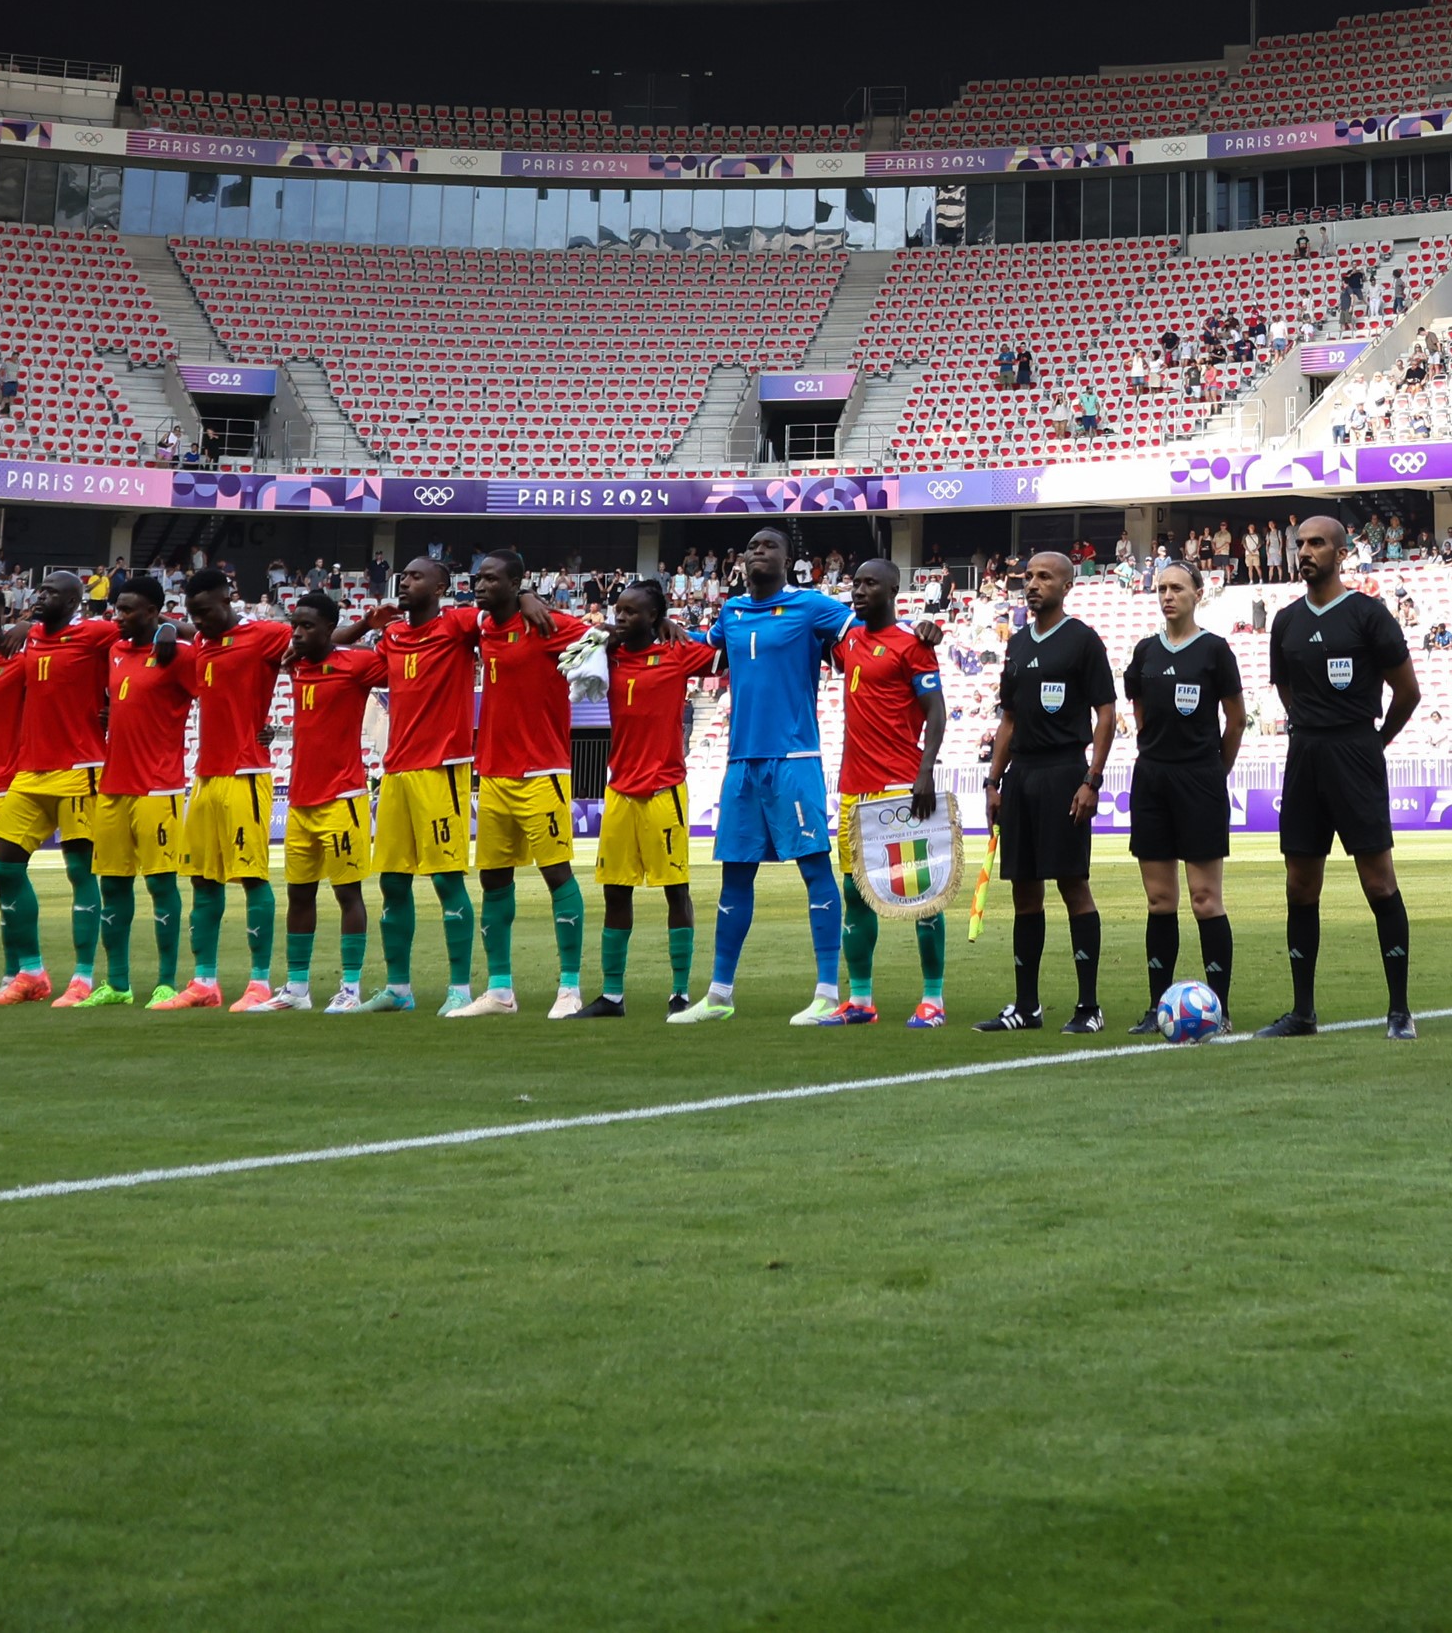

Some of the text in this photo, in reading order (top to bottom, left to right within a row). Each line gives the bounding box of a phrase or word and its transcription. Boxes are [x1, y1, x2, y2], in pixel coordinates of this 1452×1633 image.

[1277, 131, 1318, 147] 2024
[208, 144, 256, 158] 2024
[940, 156, 986, 168] 2024
[582, 159, 629, 172] 2024
[1329, 351, 1346, 365] D2
[208, 372, 241, 386] C2.2
[794, 380, 823, 394] C2.1
[84, 476, 145, 495] 2024
[602, 490, 669, 506] 2024
[750, 632, 756, 659] 1
[38, 657, 51, 680] 17
[204, 663, 212, 687] 4
[404, 653, 417, 679] 13
[490, 658, 497, 683] 3
[119, 676, 129, 700] 6
[627, 679, 634, 705] 7
[921, 674, 936, 688] C
[302, 687, 315, 710] 14
[795, 802, 804, 827] 1
[1392, 798, 1418, 811] 024
[157, 823, 166, 846] 6
[432, 818, 451, 844] 13
[549, 813, 558, 838] 3
[235, 827, 244, 851] 4
[332, 833, 351, 857] 14
[663, 828, 672, 855] 7
